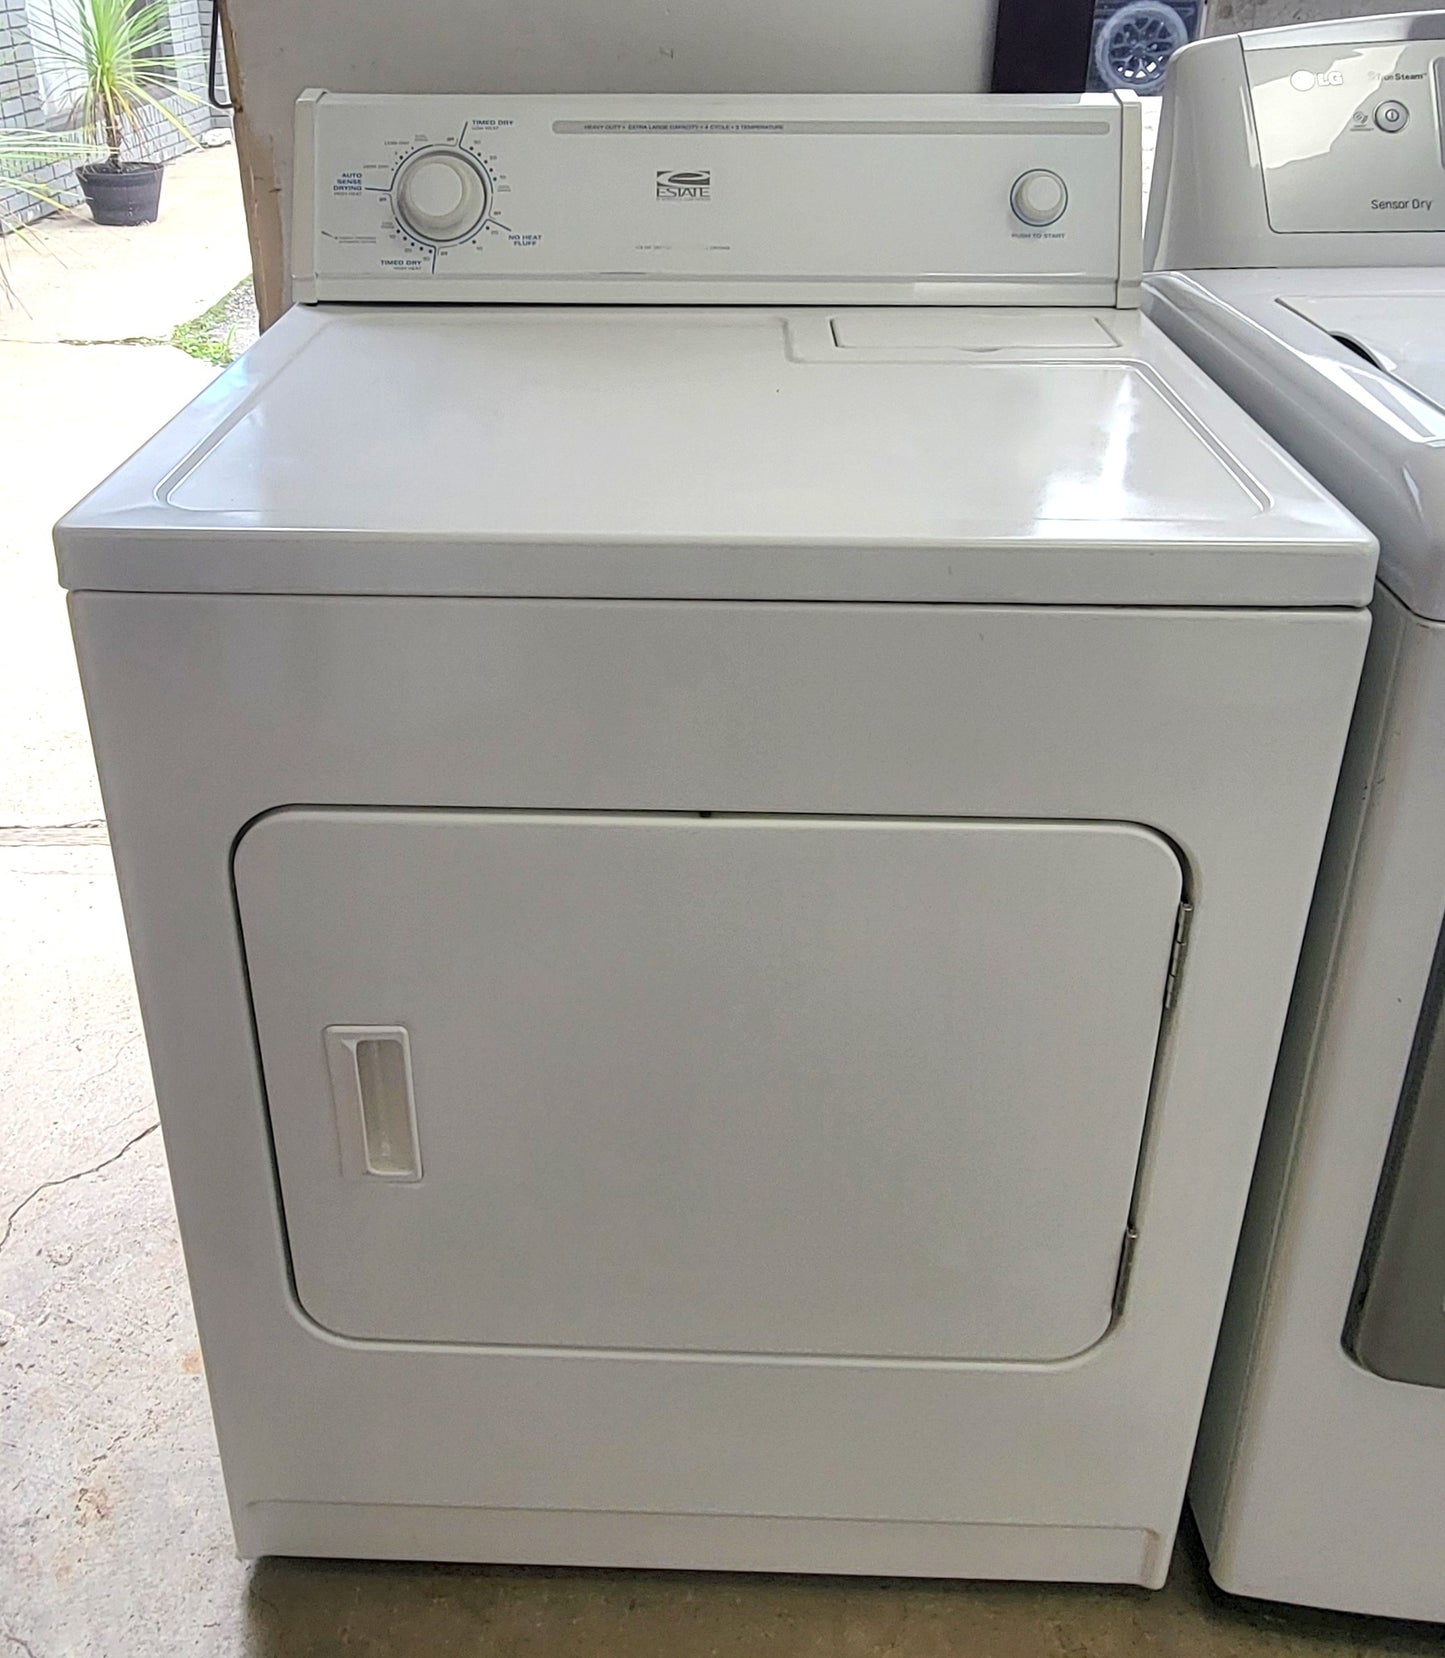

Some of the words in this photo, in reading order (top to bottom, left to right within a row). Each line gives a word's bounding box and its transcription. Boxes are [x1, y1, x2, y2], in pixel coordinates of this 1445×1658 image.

[1317, 70, 1343, 86] LG
[656, 186, 711, 198] ESTATE
[1371, 199, 1409, 210] Sensor
[1412, 199, 1434, 212] Dry
